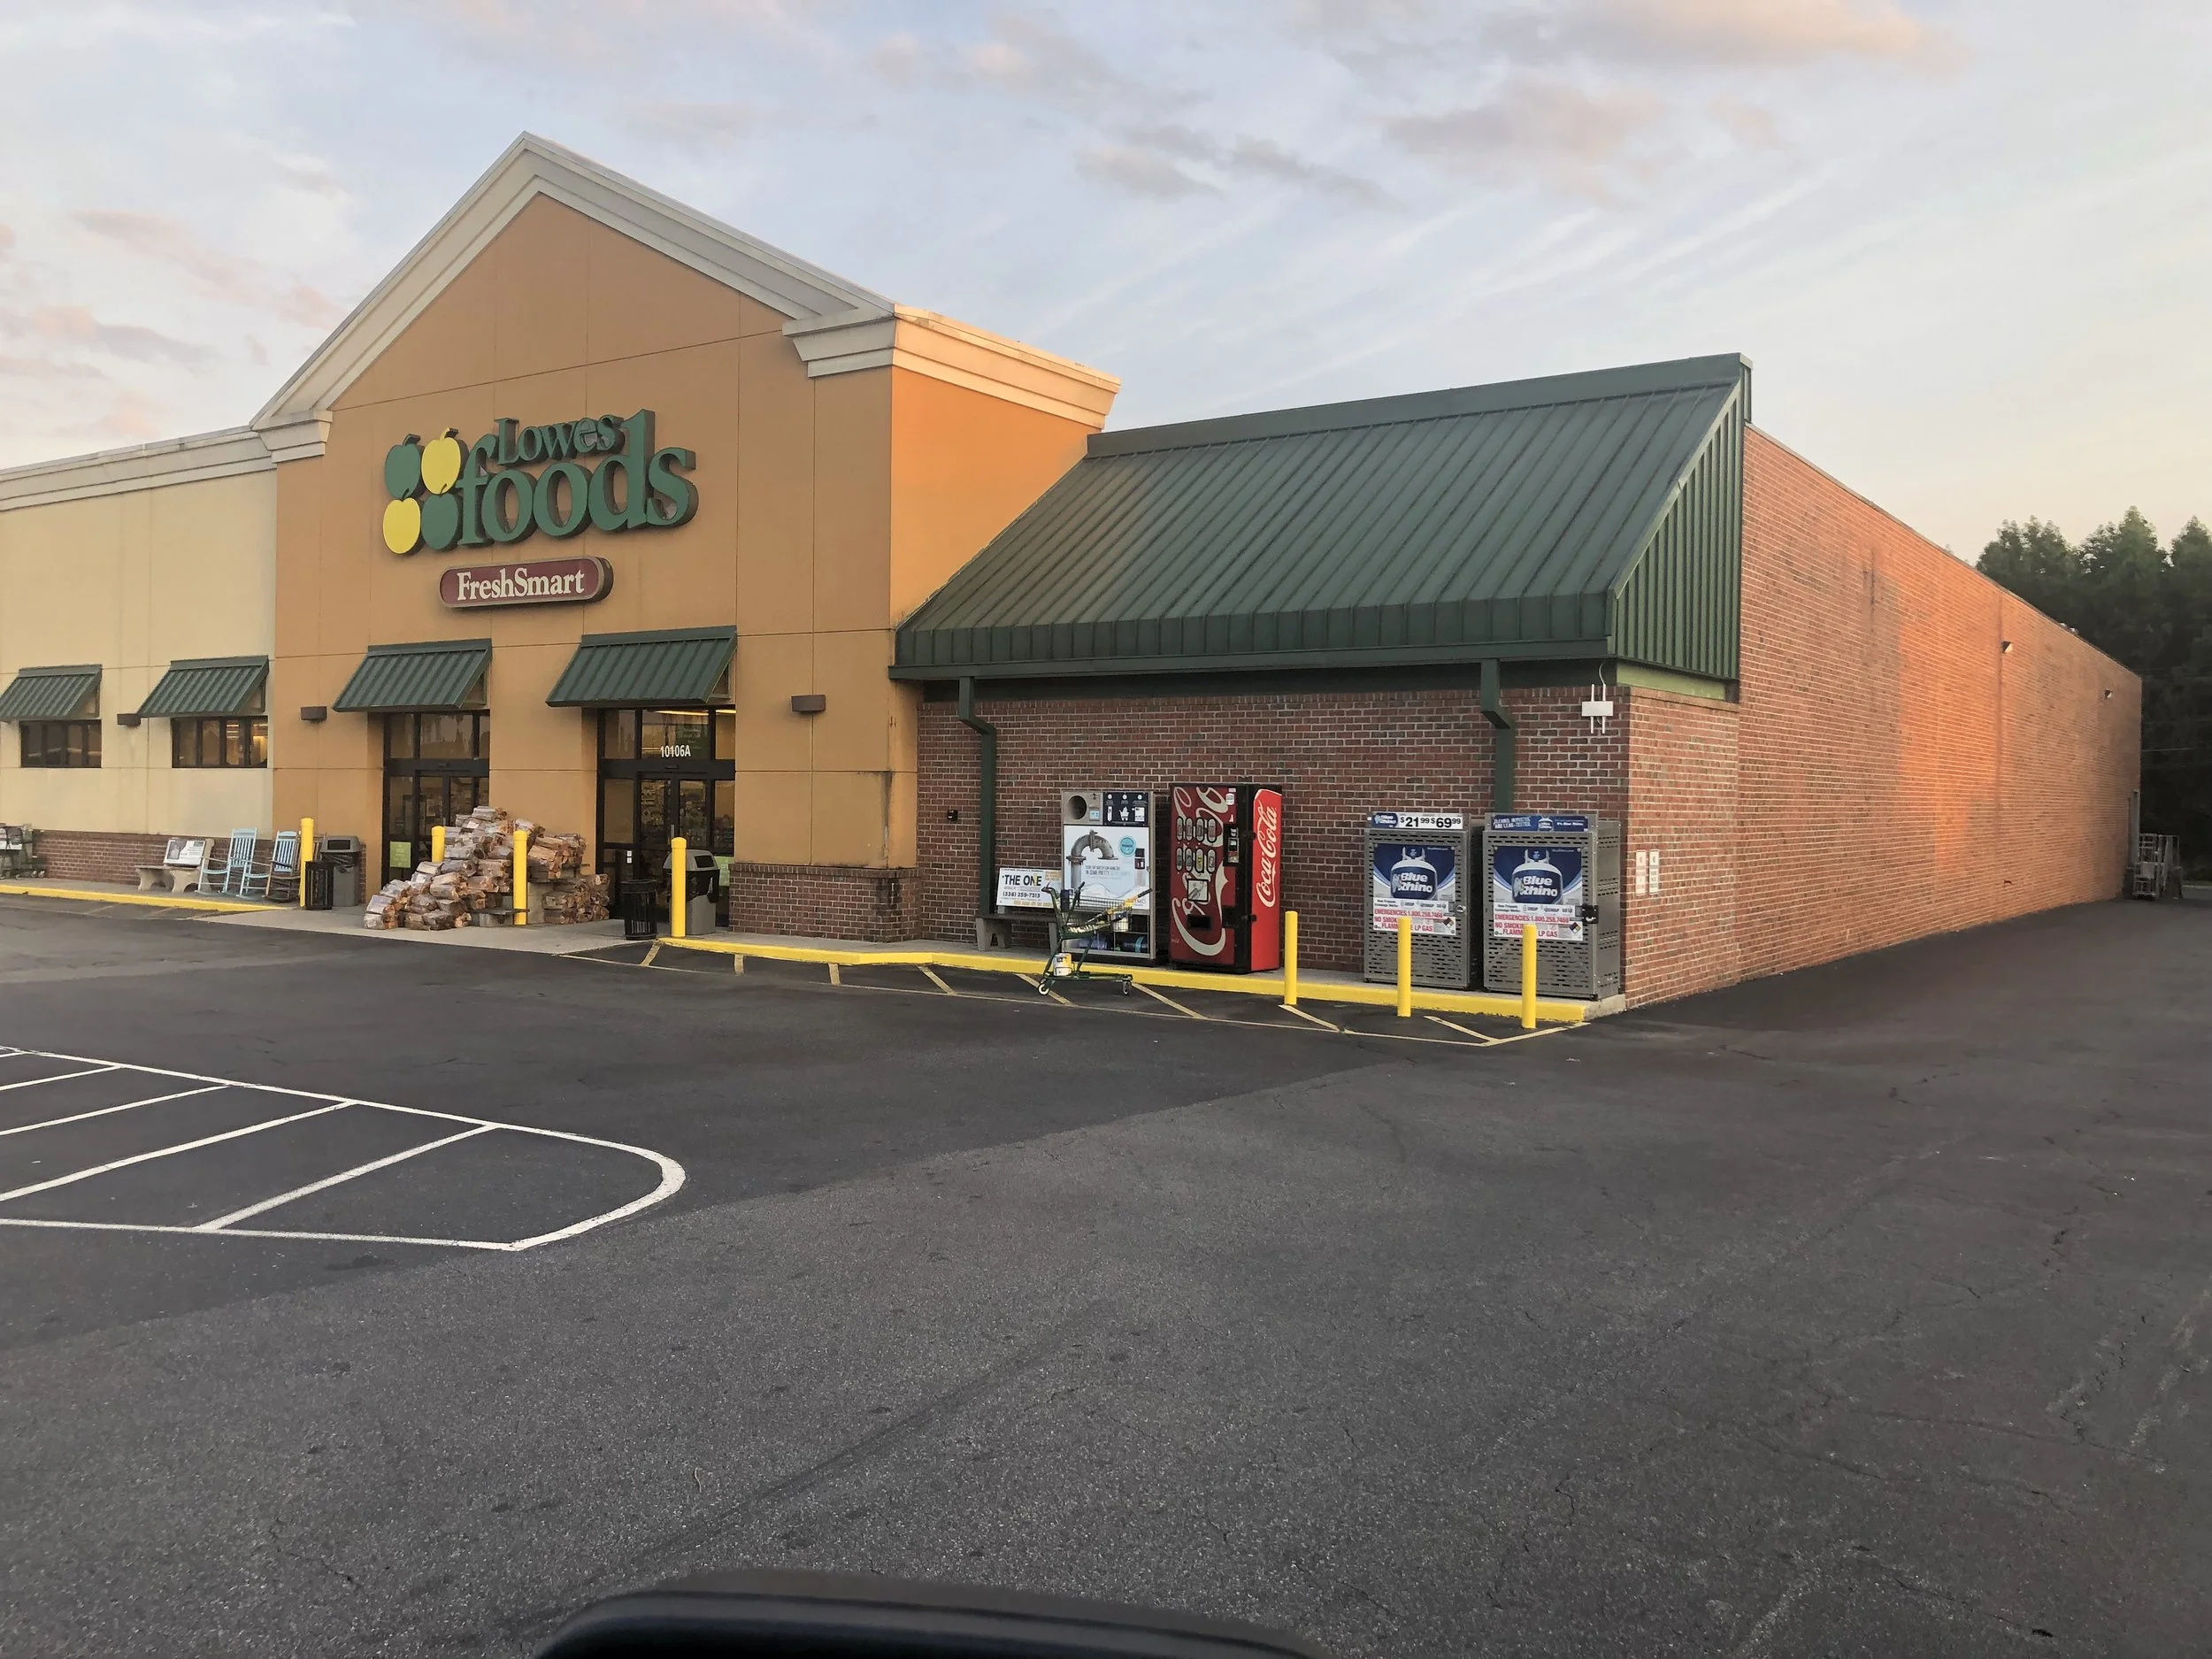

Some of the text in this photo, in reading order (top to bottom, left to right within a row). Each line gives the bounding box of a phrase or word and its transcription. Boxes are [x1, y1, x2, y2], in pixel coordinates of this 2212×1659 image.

[495, 413, 624, 465] Lowes
[455, 409, 699, 546] foods
[457, 566, 585, 601] FreshSmart
[660, 744, 692, 758] 10106A
[1256, 799, 1278, 908] Coca-Cola
[1004, 874, 1021, 886] THE
[1023, 875, 1042, 887] ONE
[1400, 872, 1428, 882] Blue
[1523, 875, 1553, 886] Blue
